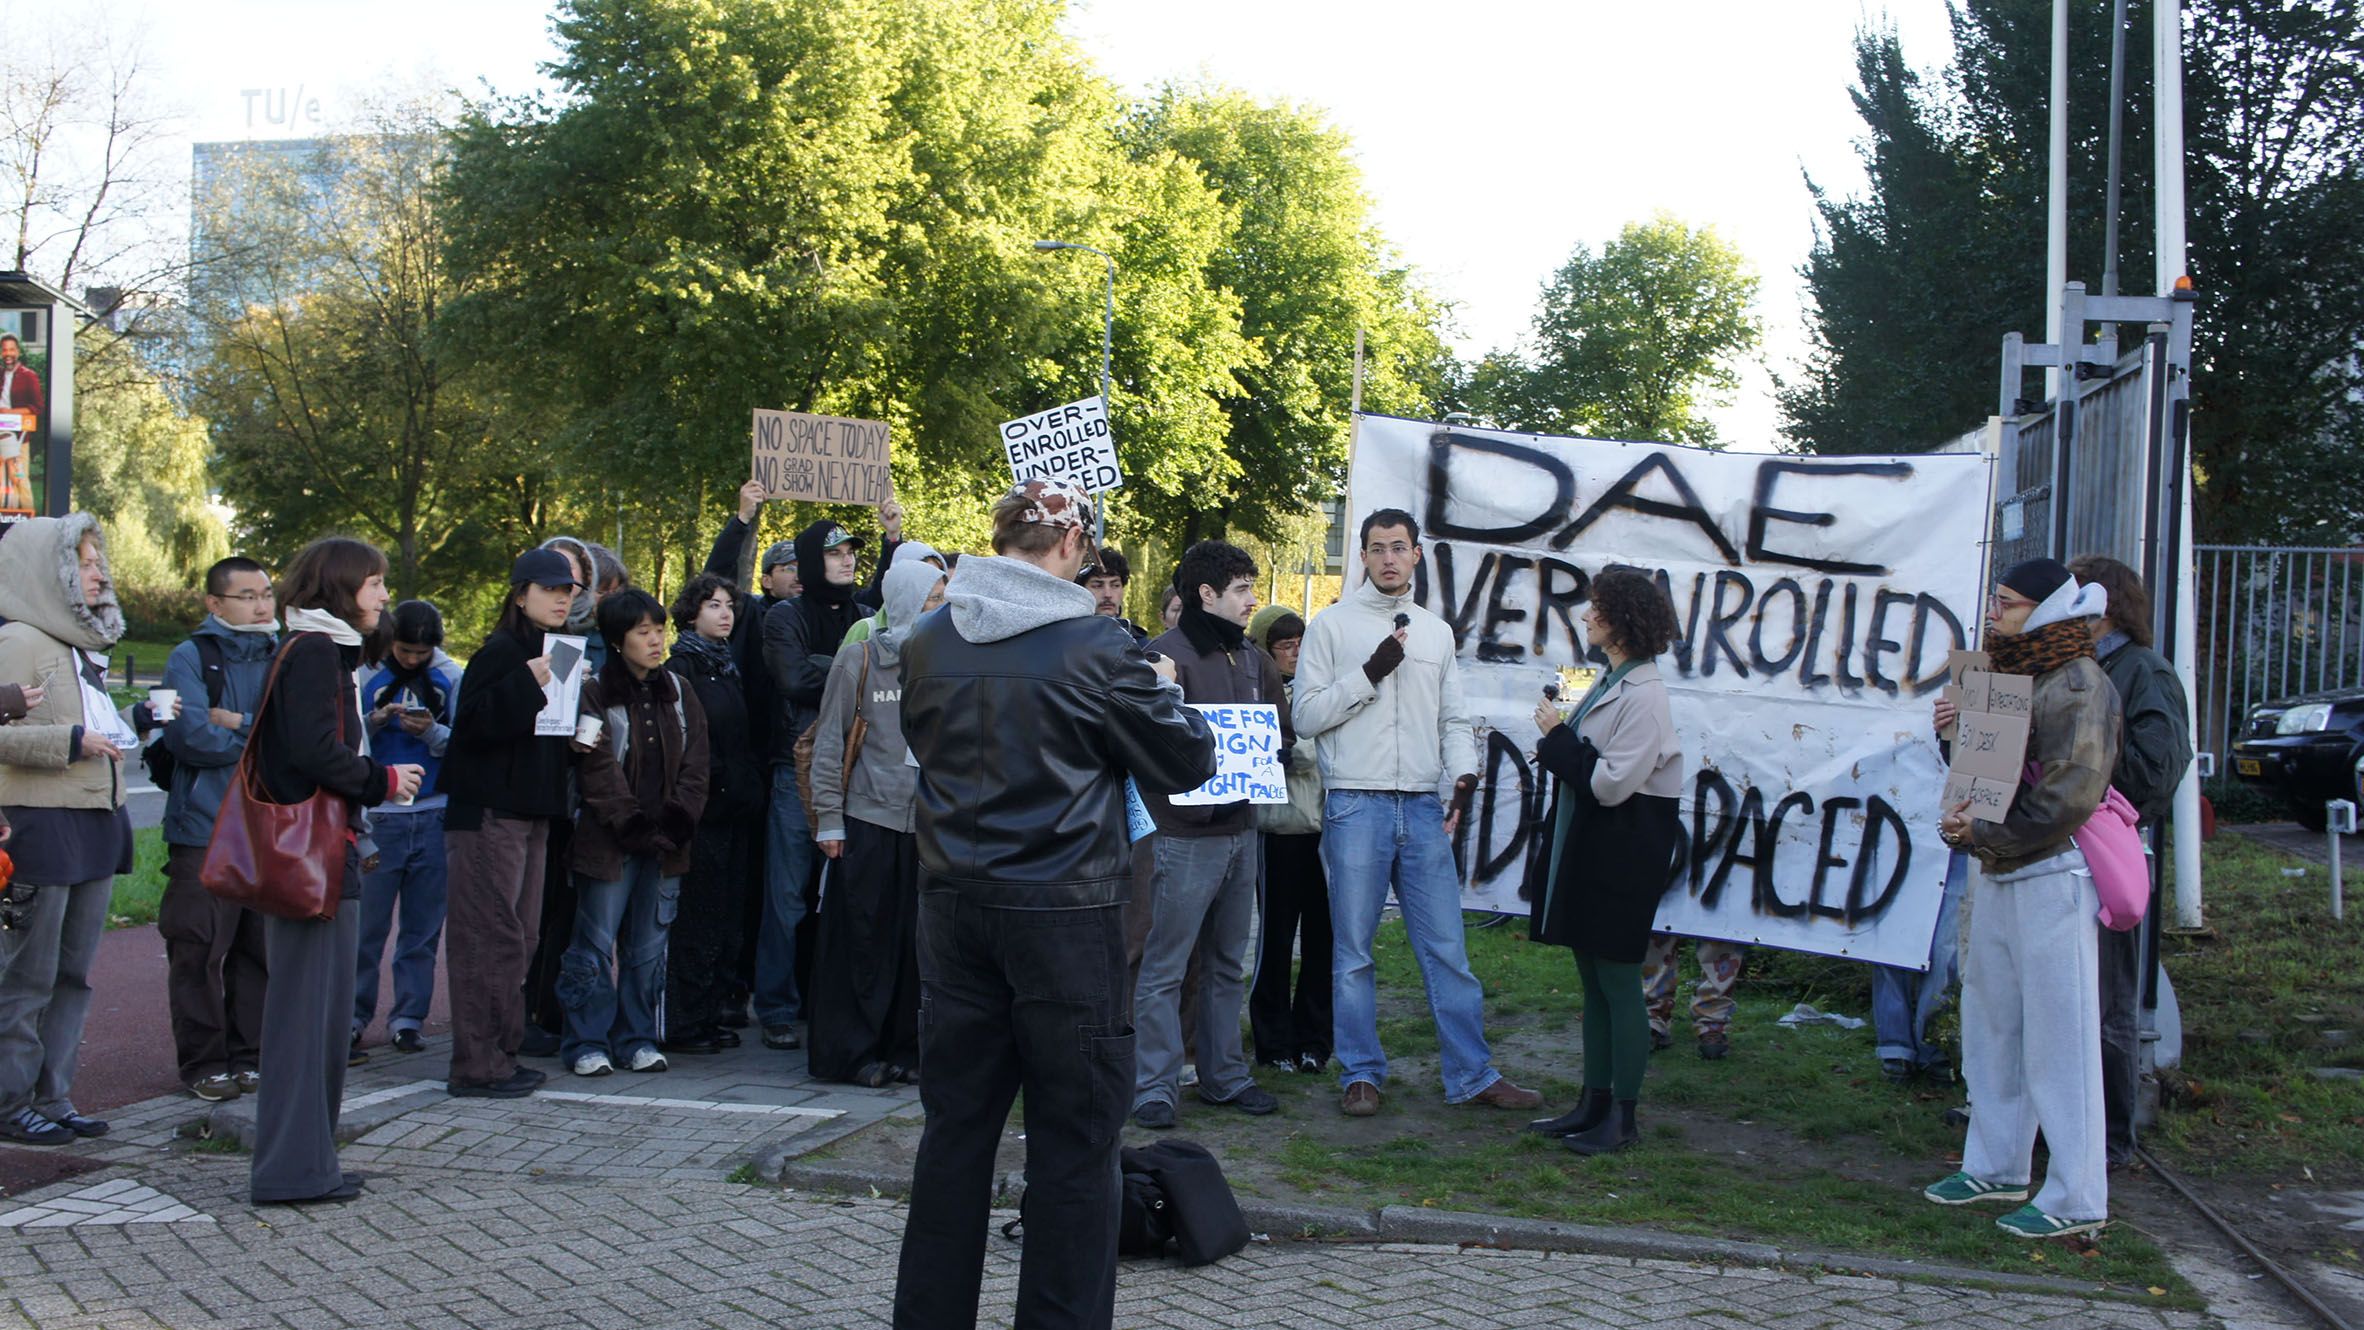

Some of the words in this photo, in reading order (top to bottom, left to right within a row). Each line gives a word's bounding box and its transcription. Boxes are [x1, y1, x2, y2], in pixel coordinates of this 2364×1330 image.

[240, 83, 321, 130] TU/e
[758, 416, 782, 450] NO
[787, 418, 833, 457] SPACE
[838, 422, 888, 461] TODAY
[1005, 406, 1098, 439] OVER-
[1009, 418, 1107, 464] ENROLLED
[756, 456, 778, 494] NO
[783, 458, 814, 472] GRAD
[817, 461, 860, 501] NEXT
[861, 464, 890, 502] YEAR
[782, 474, 815, 493] SHOW
[1424, 432, 1914, 577] DAE
[1240, 709, 1277, 731] FOR
[1185, 772, 1252, 797] IGHT
[1261, 767, 1274, 776] A
